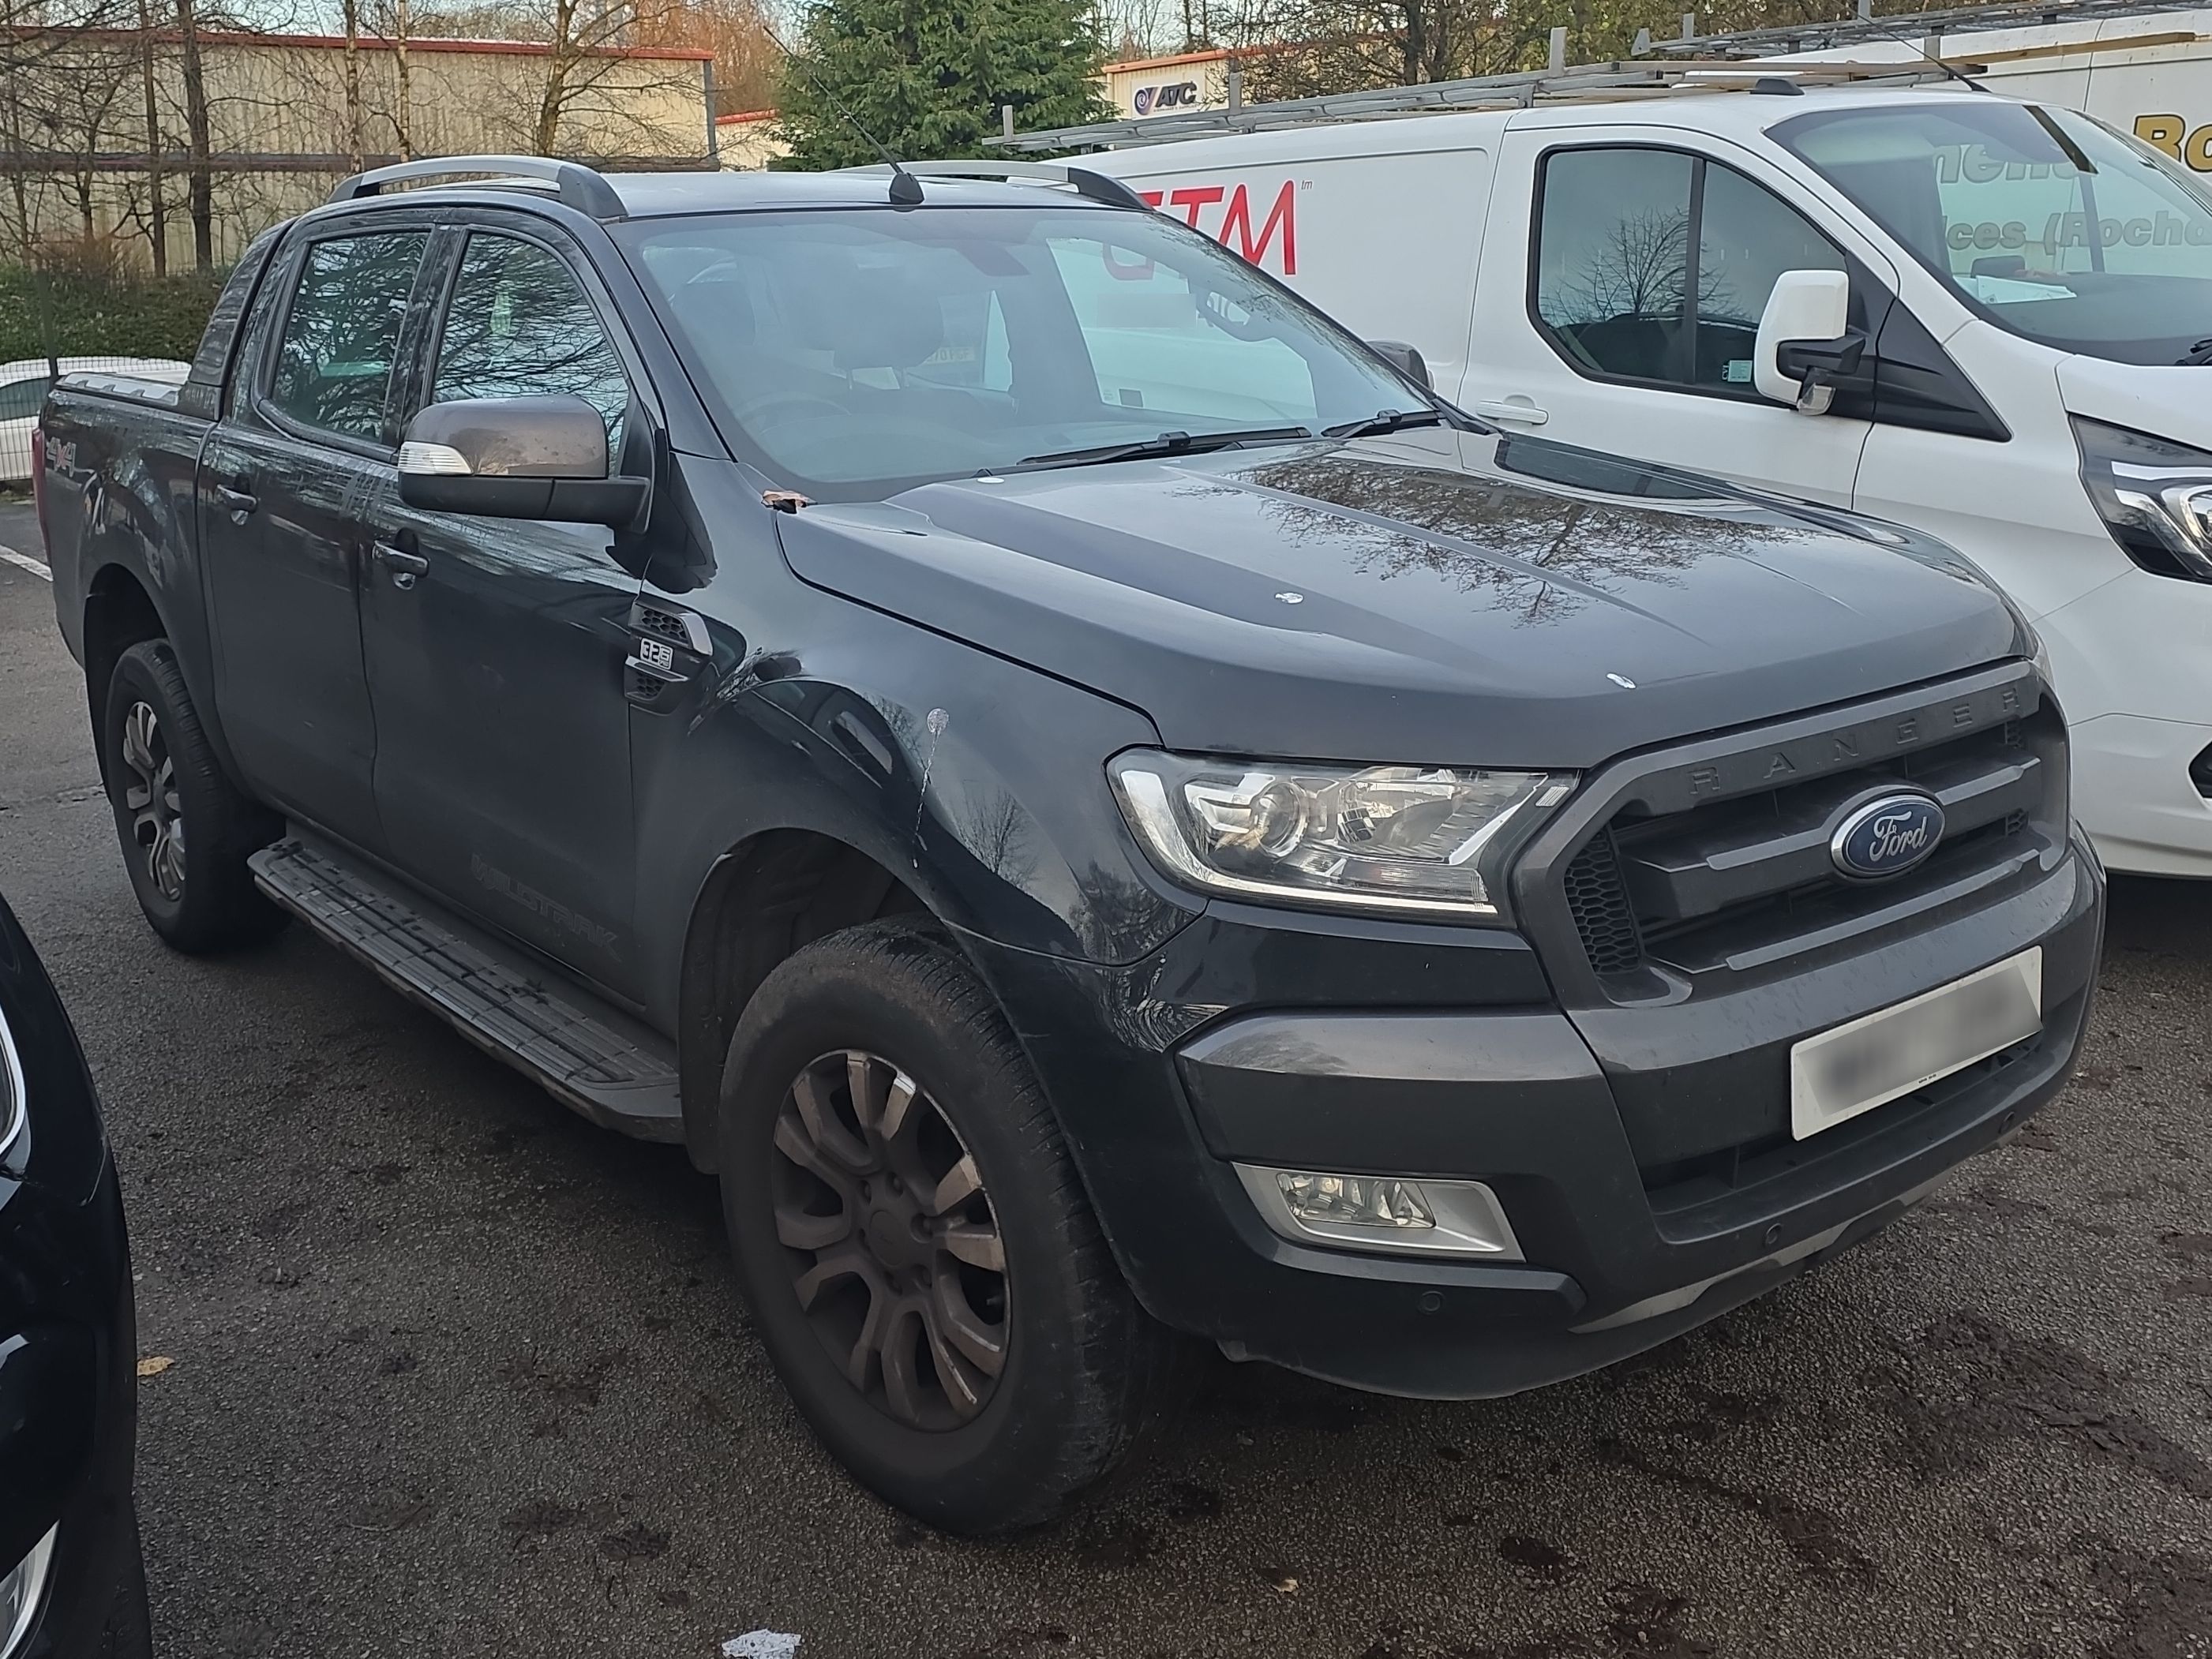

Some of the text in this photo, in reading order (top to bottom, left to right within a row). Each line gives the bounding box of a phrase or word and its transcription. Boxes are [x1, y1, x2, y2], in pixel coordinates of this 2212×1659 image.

[1155, 82, 1198, 108] ATC
[1687, 687, 2021, 796] RANGER
[1868, 810, 1929, 863] Ford
